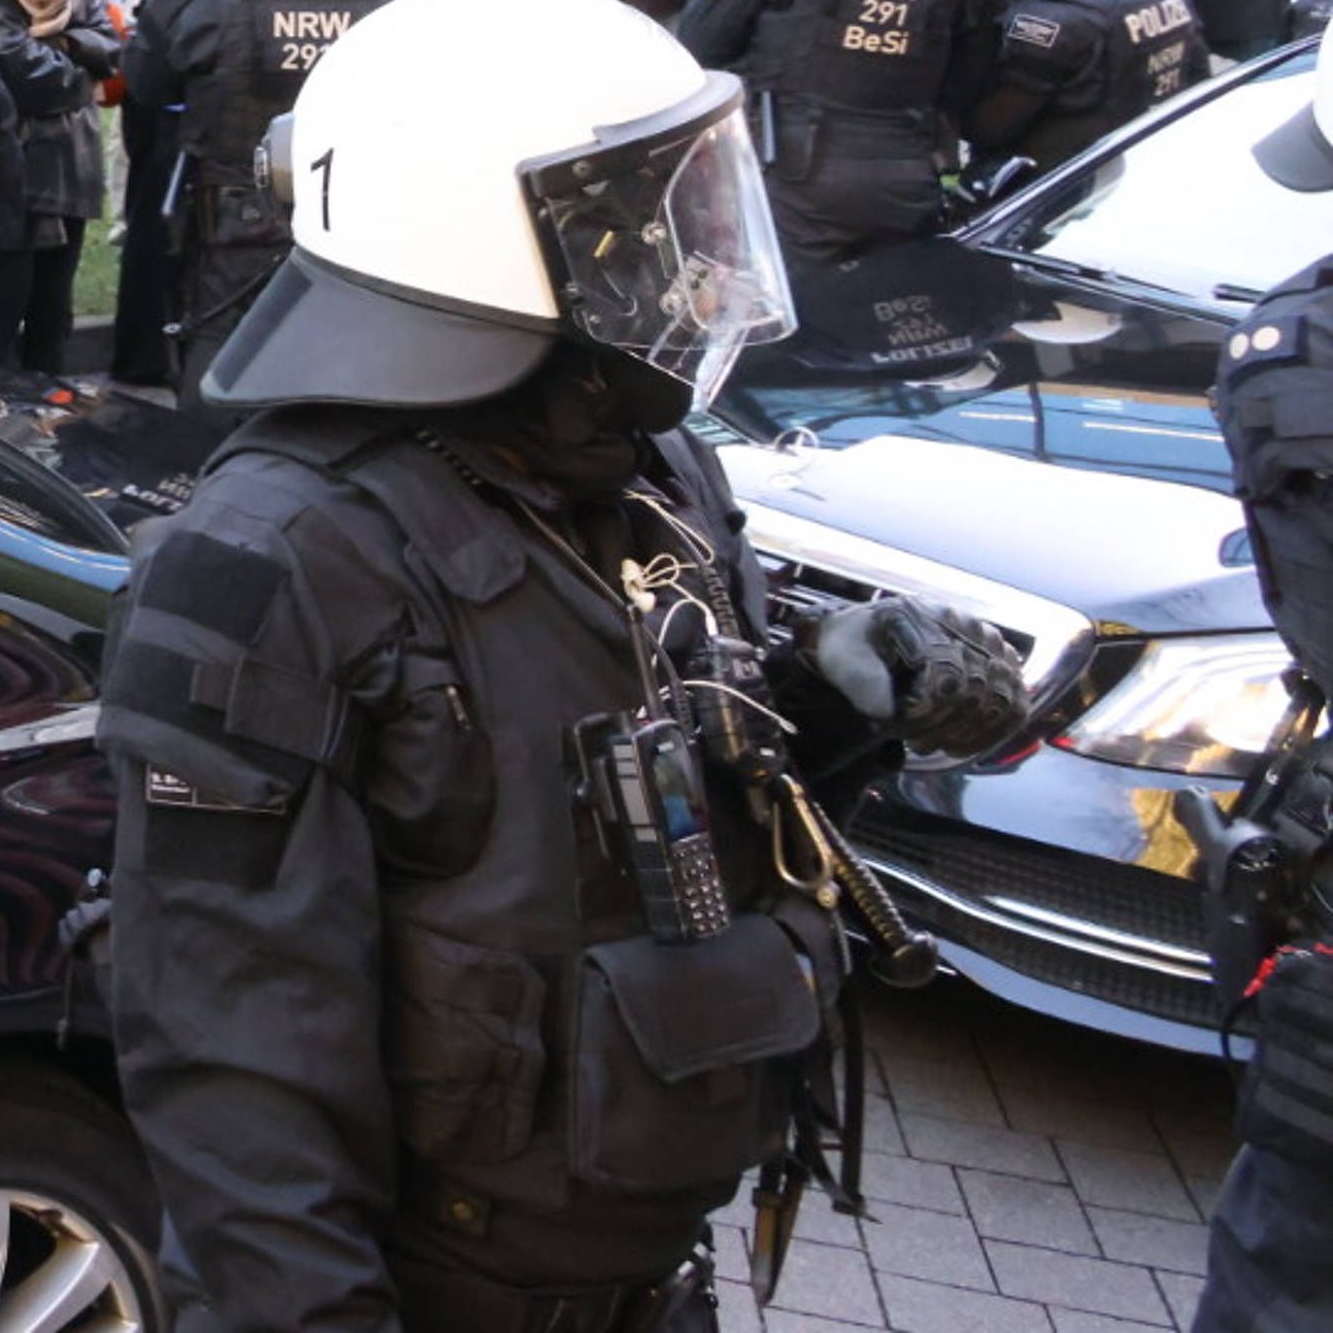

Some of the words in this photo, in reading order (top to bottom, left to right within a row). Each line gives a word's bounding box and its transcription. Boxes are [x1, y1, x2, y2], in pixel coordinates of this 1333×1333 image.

[273, 11, 351, 38] NRW
[842, 25, 909, 56] BeSi
[310, 146, 334, 232] 1
